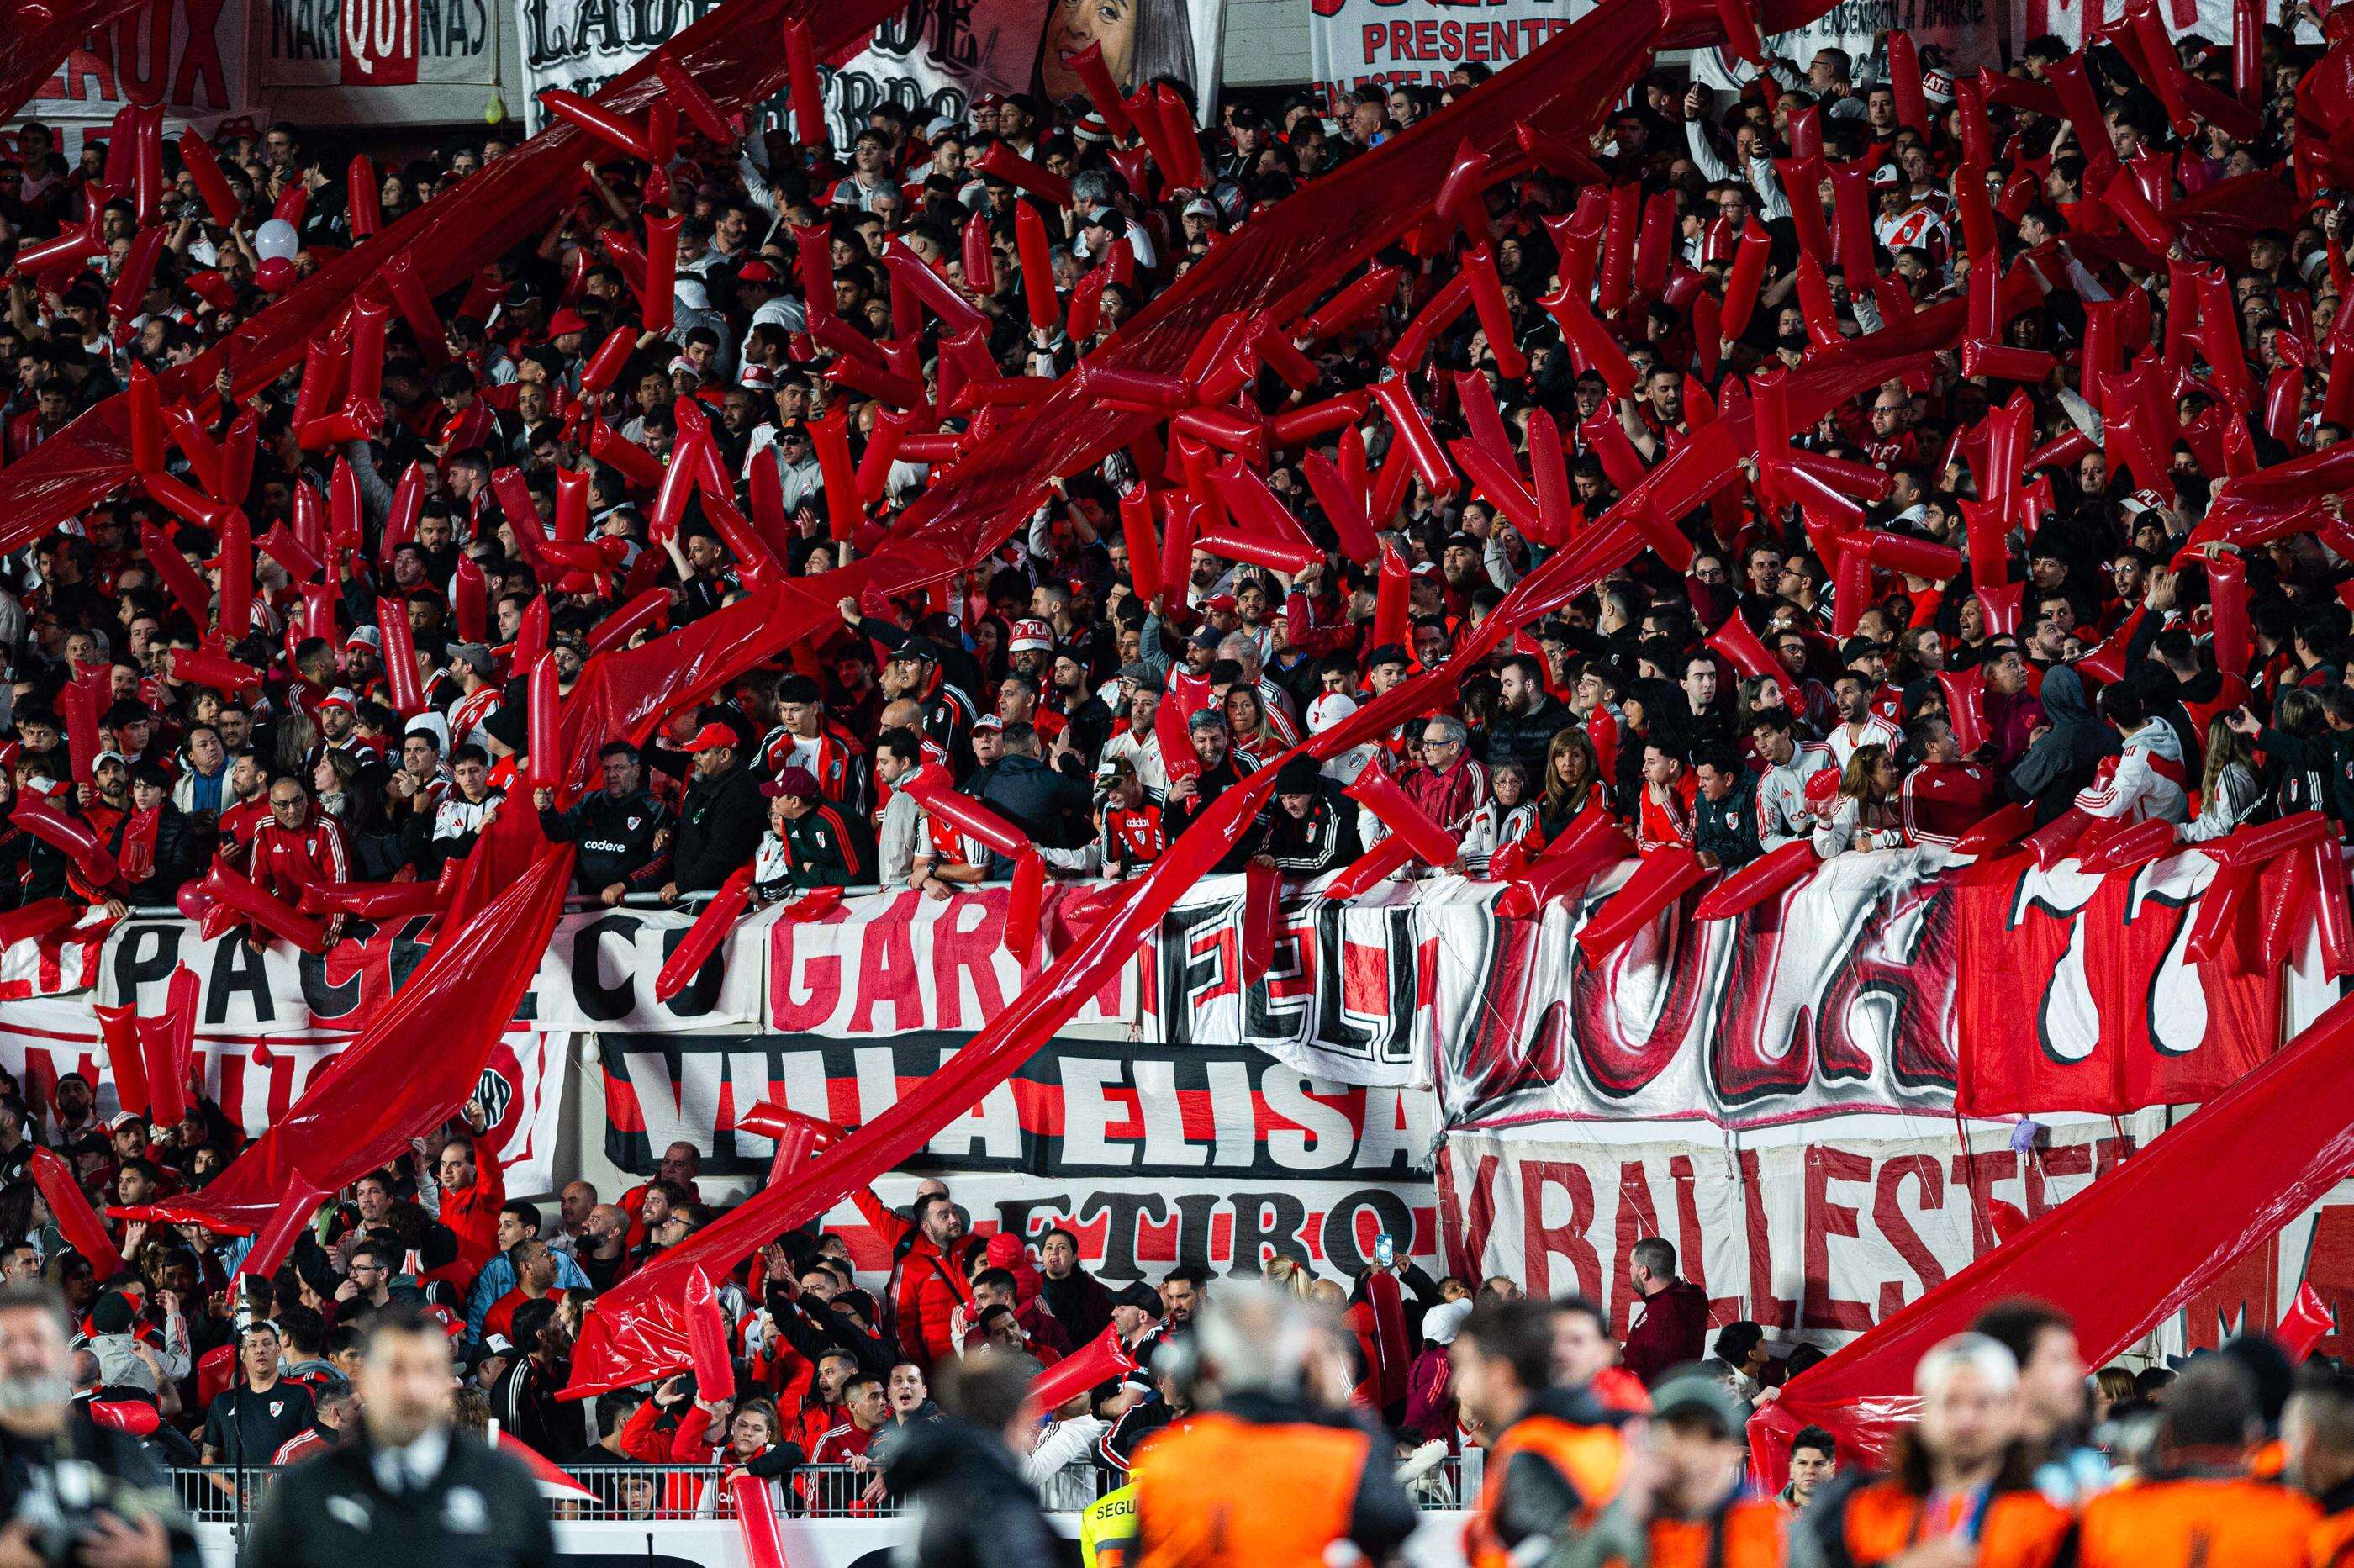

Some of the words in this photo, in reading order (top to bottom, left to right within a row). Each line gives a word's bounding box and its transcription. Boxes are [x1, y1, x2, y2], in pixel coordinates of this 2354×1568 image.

[584, 839, 625, 853] codere
[2007, 847, 2217, 1066] 77
[1058, 1055, 1434, 1170] ELISA
